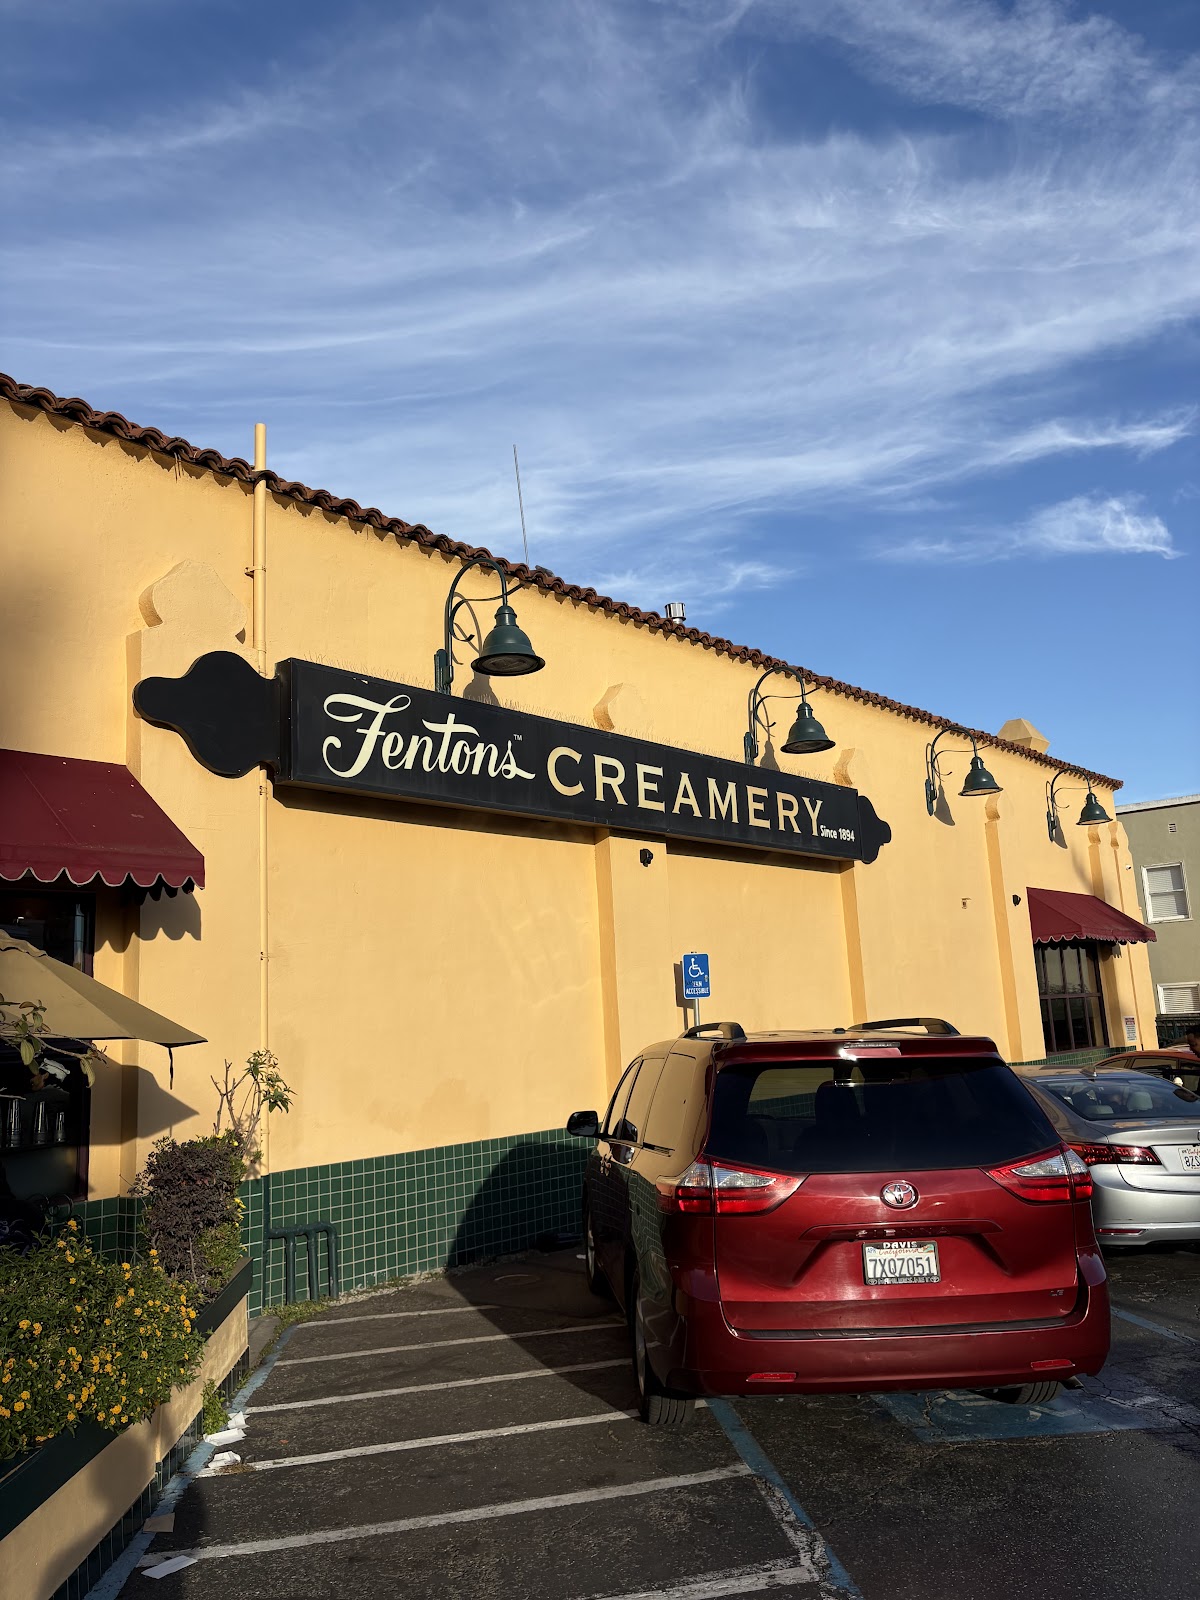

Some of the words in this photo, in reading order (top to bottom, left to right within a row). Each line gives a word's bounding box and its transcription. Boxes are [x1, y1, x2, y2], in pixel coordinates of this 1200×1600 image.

[546, 746, 824, 837] CREAMERY
[820, 824, 838, 840] Since
[838, 827, 856, 843] 1894
[1184, 1155, 1200, 1167] 8ZS
[879, 1248, 922, 1257] California
[883, 1241, 918, 1249] DAVIS
[868, 1257, 934, 1278] 7XQZ051
